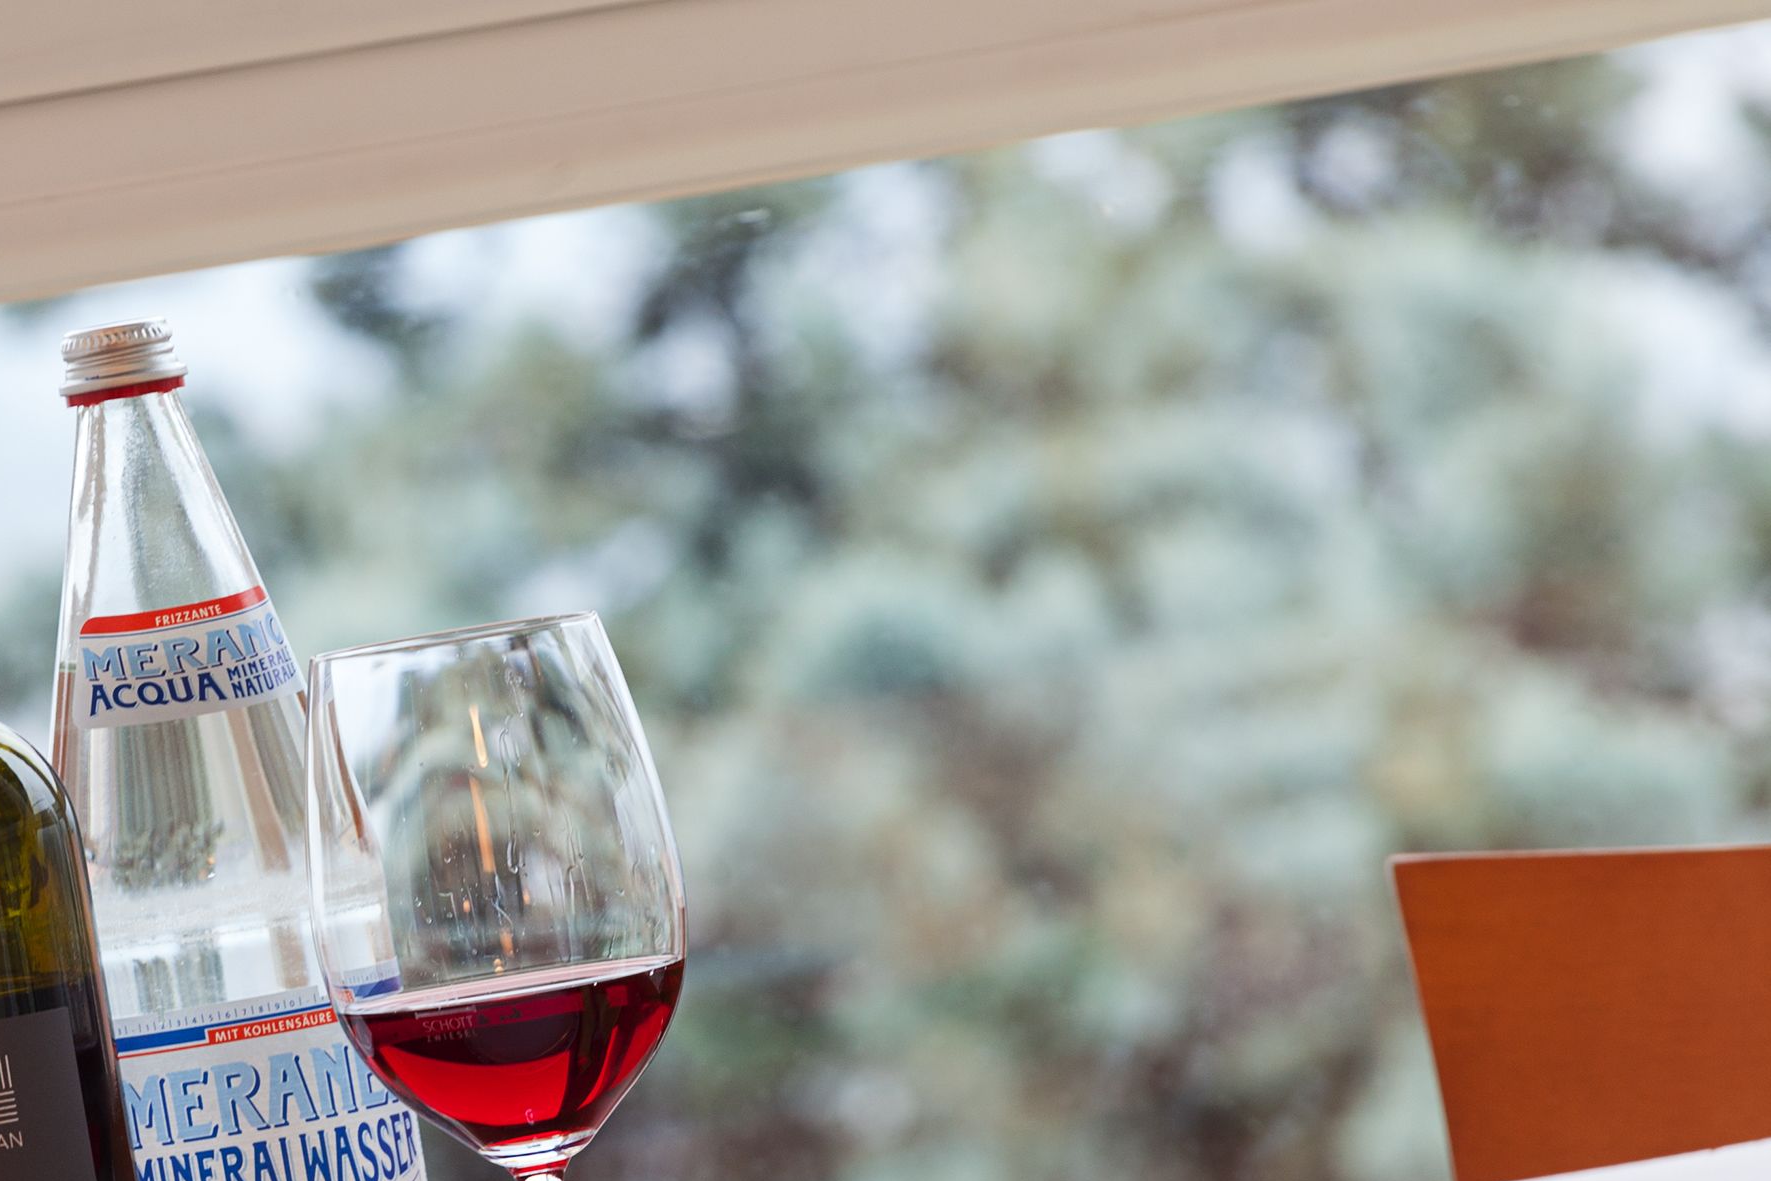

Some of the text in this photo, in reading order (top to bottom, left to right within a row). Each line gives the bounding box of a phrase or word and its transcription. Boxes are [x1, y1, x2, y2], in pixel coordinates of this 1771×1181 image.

[155, 604, 222, 626] FRIZZANTE
[90, 673, 228, 717] ACQUA
[215, 1010, 333, 1043] MIT KOHLENSÄURE
[423, 1015, 474, 1033] SCHOTT
